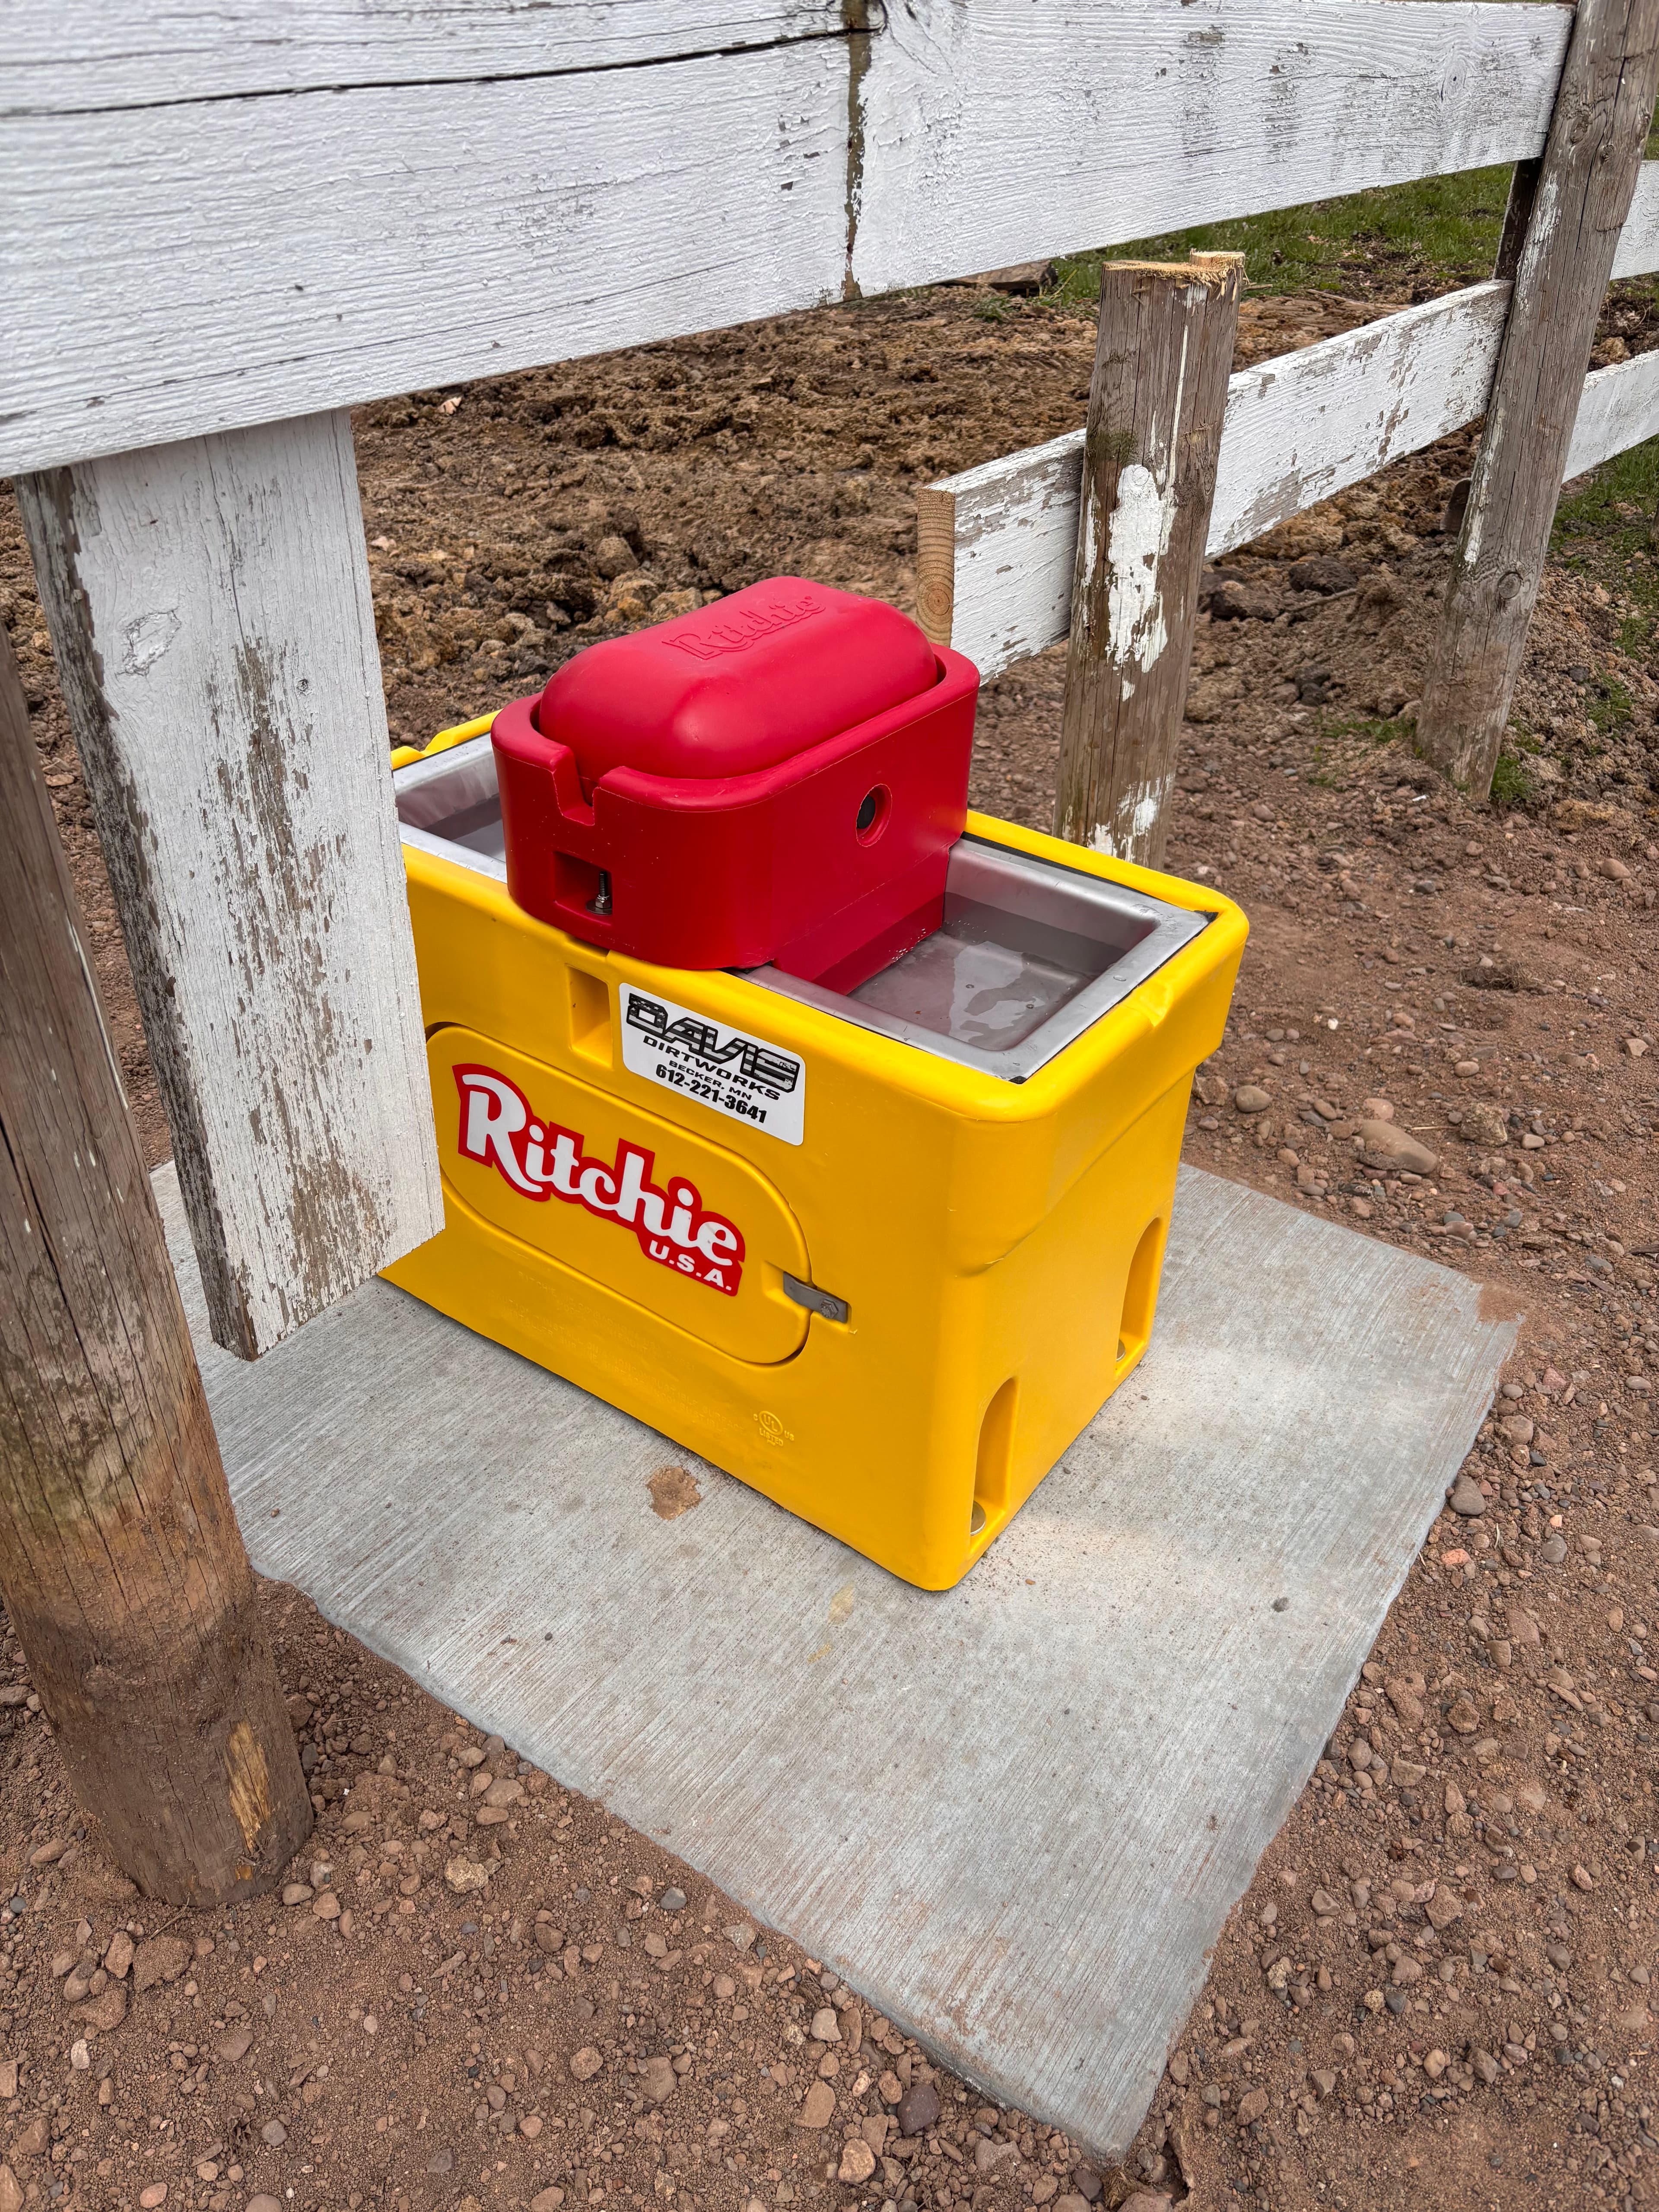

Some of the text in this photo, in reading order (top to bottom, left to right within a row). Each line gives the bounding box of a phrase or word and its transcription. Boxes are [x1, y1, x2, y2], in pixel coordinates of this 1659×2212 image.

[666, 598, 823, 657] Ritchie
[626, 993, 800, 1093] DAVIS
[643, 1035, 781, 1100] DIRTWORKS
[655, 1064, 767, 1124] 612-221-3641
[669, 1060, 752, 1100] BECKER, MN
[462, 1074, 737, 1266] Ritchie
[649, 1239, 732, 1291] U.S.A.
[759, 1427, 783, 1446] LISTED
[763, 1414, 778, 1432] UL
